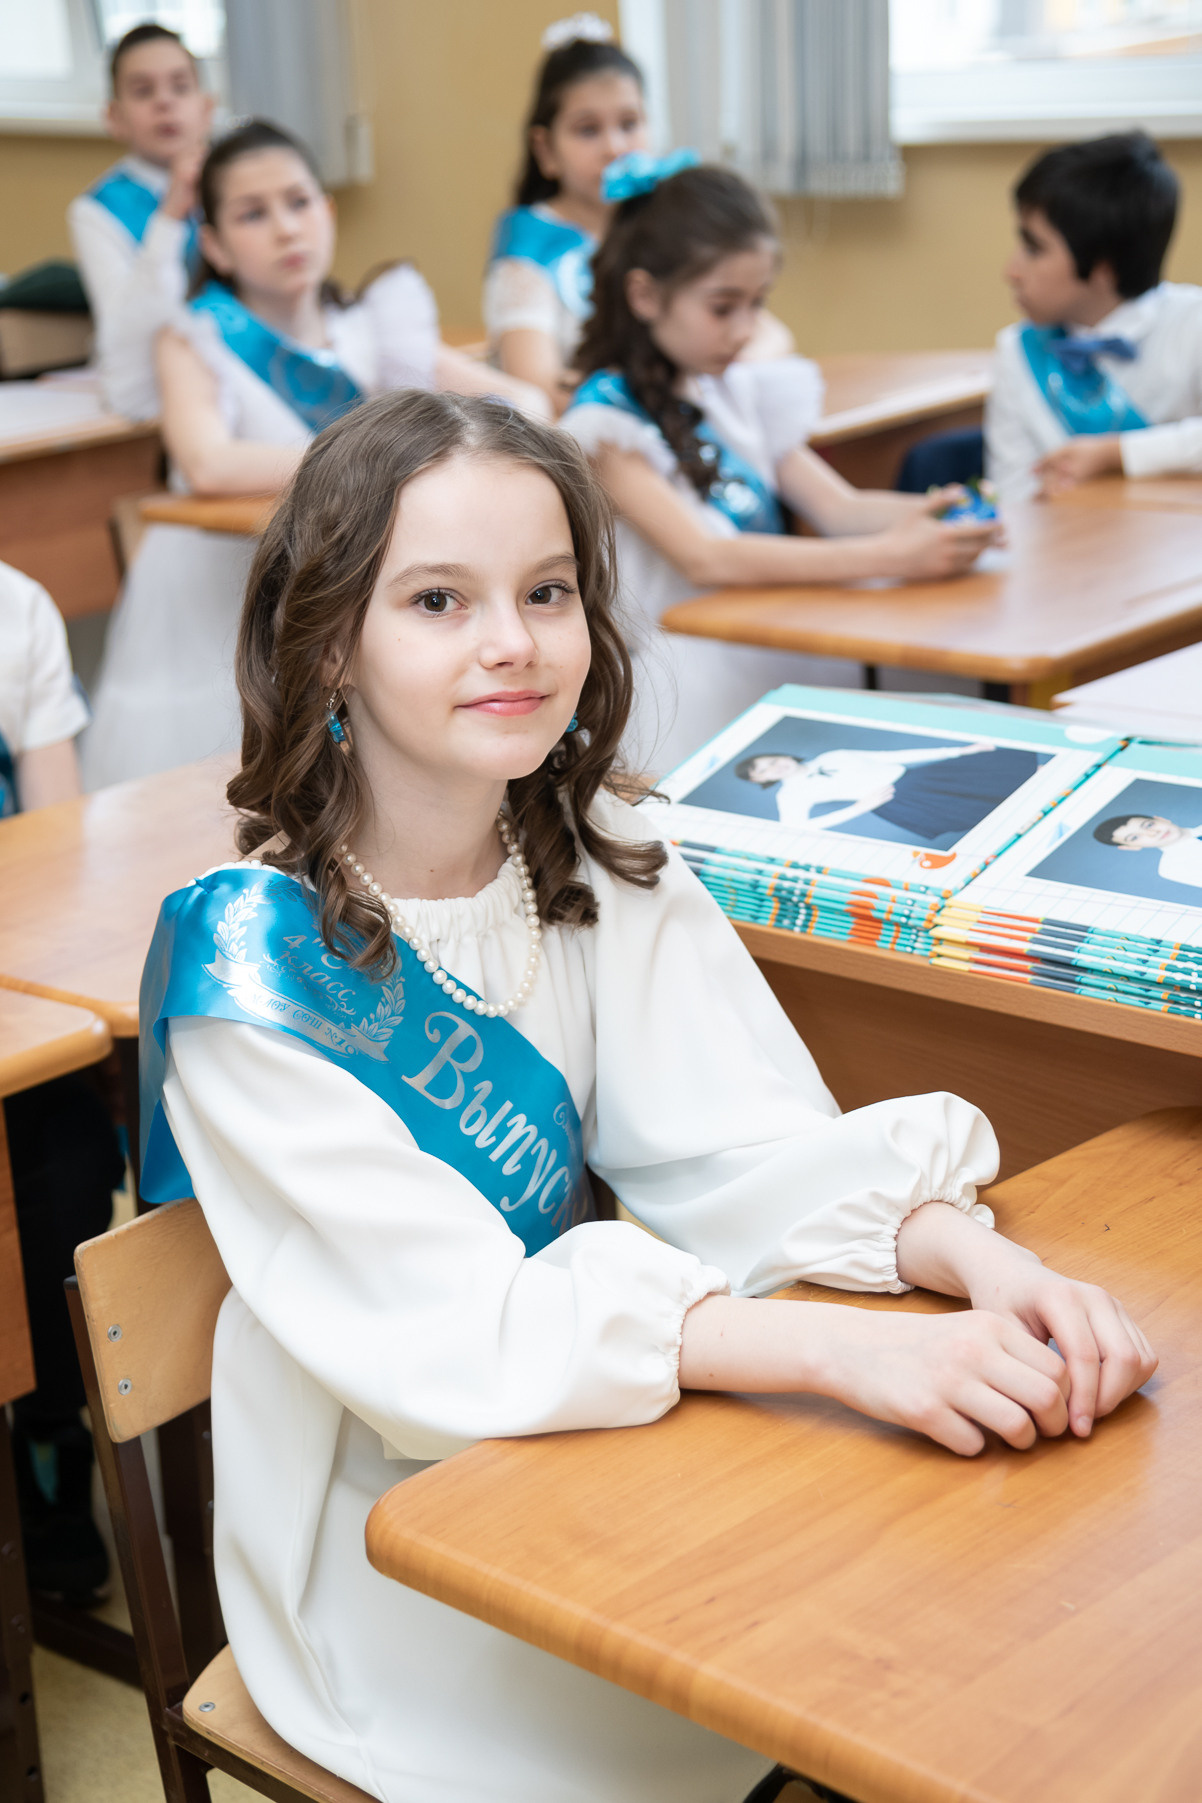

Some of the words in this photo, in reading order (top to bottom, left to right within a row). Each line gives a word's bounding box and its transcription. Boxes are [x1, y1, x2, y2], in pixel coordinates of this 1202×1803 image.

[282, 934, 307, 949] 4
[279, 950, 357, 1001] класс
[292, 1008, 323, 1030] СОШ
